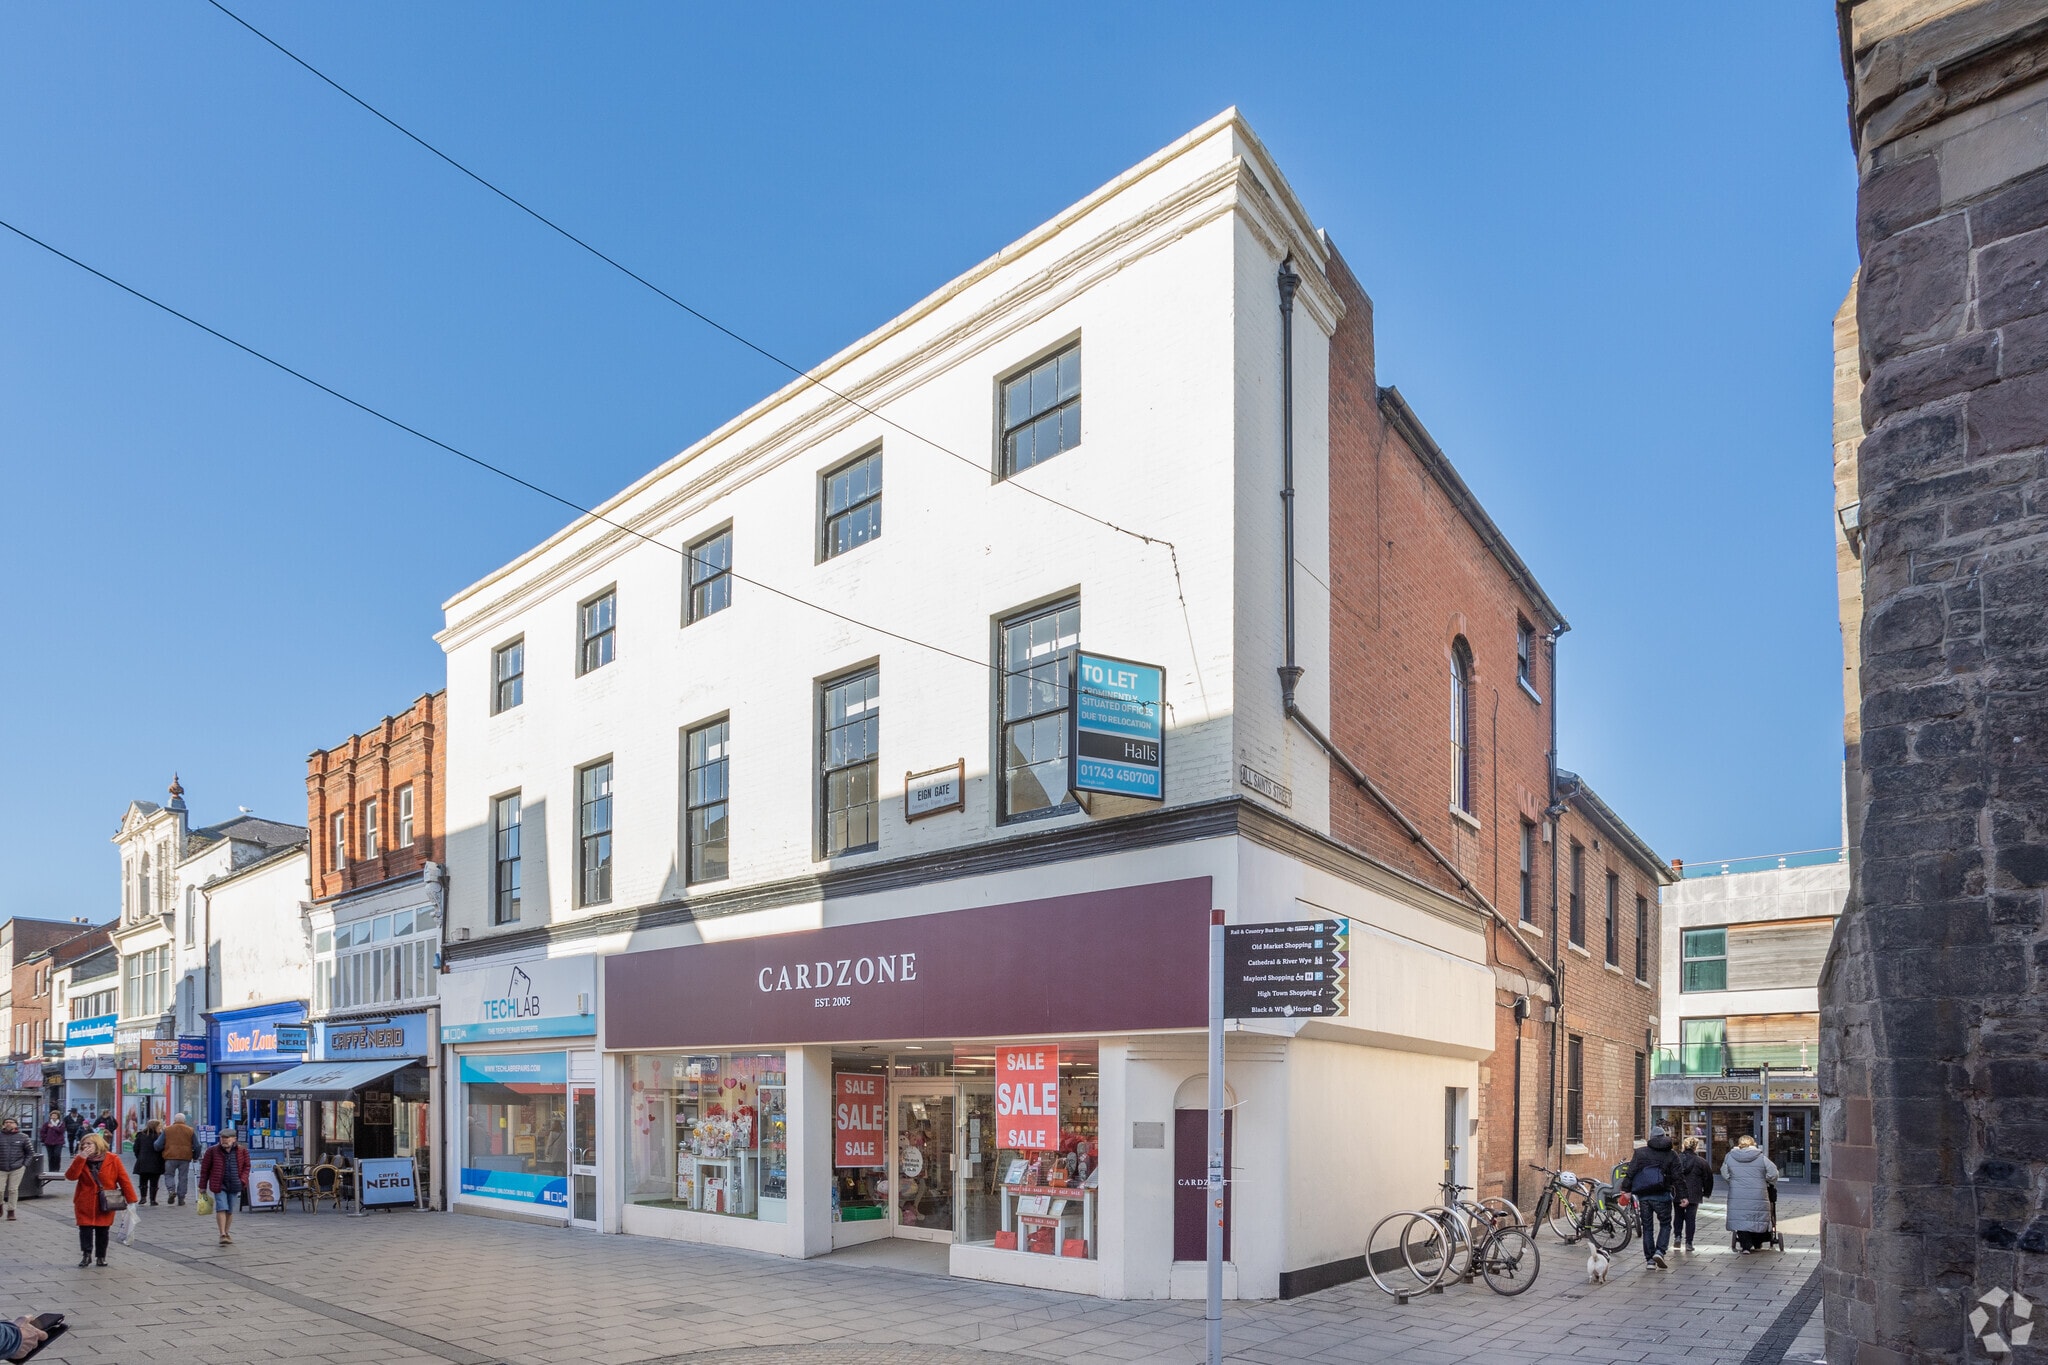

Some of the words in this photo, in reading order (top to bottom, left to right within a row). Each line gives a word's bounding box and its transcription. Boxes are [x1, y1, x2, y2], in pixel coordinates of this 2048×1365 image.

[1082, 664, 1103, 684] TO
[1108, 668, 1138, 690] LET
[1082, 698, 1120, 711] SITUATED
[1121, 704, 1154, 717] OFFICES
[1082, 711, 1096, 721] DUE
[1098, 714, 1107, 722] TO
[1108, 715, 1152, 730] RELOCATION
[1124, 742, 1157, 762] Halls
[1081, 764, 1114, 779] 01743
[1117, 769, 1155, 785] 450700
[918, 788, 932, 801] EIGN
[935, 784, 950, 797] GATE
[1253, 774, 1272, 794] SAINTS
[1263, 942, 1284, 950] Market
[1285, 941, 1312, 949] Shopping
[1298, 957, 1312, 965] Wye
[758, 953, 917, 992] CARDZONE
[1243, 975, 1267, 983] Maylord
[1267, 974, 1295, 982] Shopping
[814, 998, 831, 1007] EST.
[832, 996, 851, 1007] 2005
[1257, 990, 1271, 998] High
[1289, 989, 1317, 997] Shopping
[483, 996, 540, 1020] TECHLAB
[331, 1025, 368, 1050] CAFFÈ
[368, 1028, 404, 1048] NERO
[496, 1027, 506, 1035] TECH
[520, 1025, 539, 1033] EXPERTS
[180, 1043, 204, 1051] Shoe
[227, 1032, 251, 1053] Shoe
[252, 1029, 278, 1051] Zone
[180, 1051, 206, 1059] Zone
[1007, 1052, 1045, 1071] SALE
[484, 1064, 541, 1073] WWW.TECHLABREPAIRS.COM
[845, 1079, 875, 1095] SALE
[1695, 1085, 1748, 1101] GABI
[997, 1082, 1057, 1116] SALE
[837, 1103, 883, 1131] SALE
[1008, 1129, 1046, 1148] SALE
[845, 1141, 875, 1156] SALE
[366, 1178, 410, 1189] NERO
